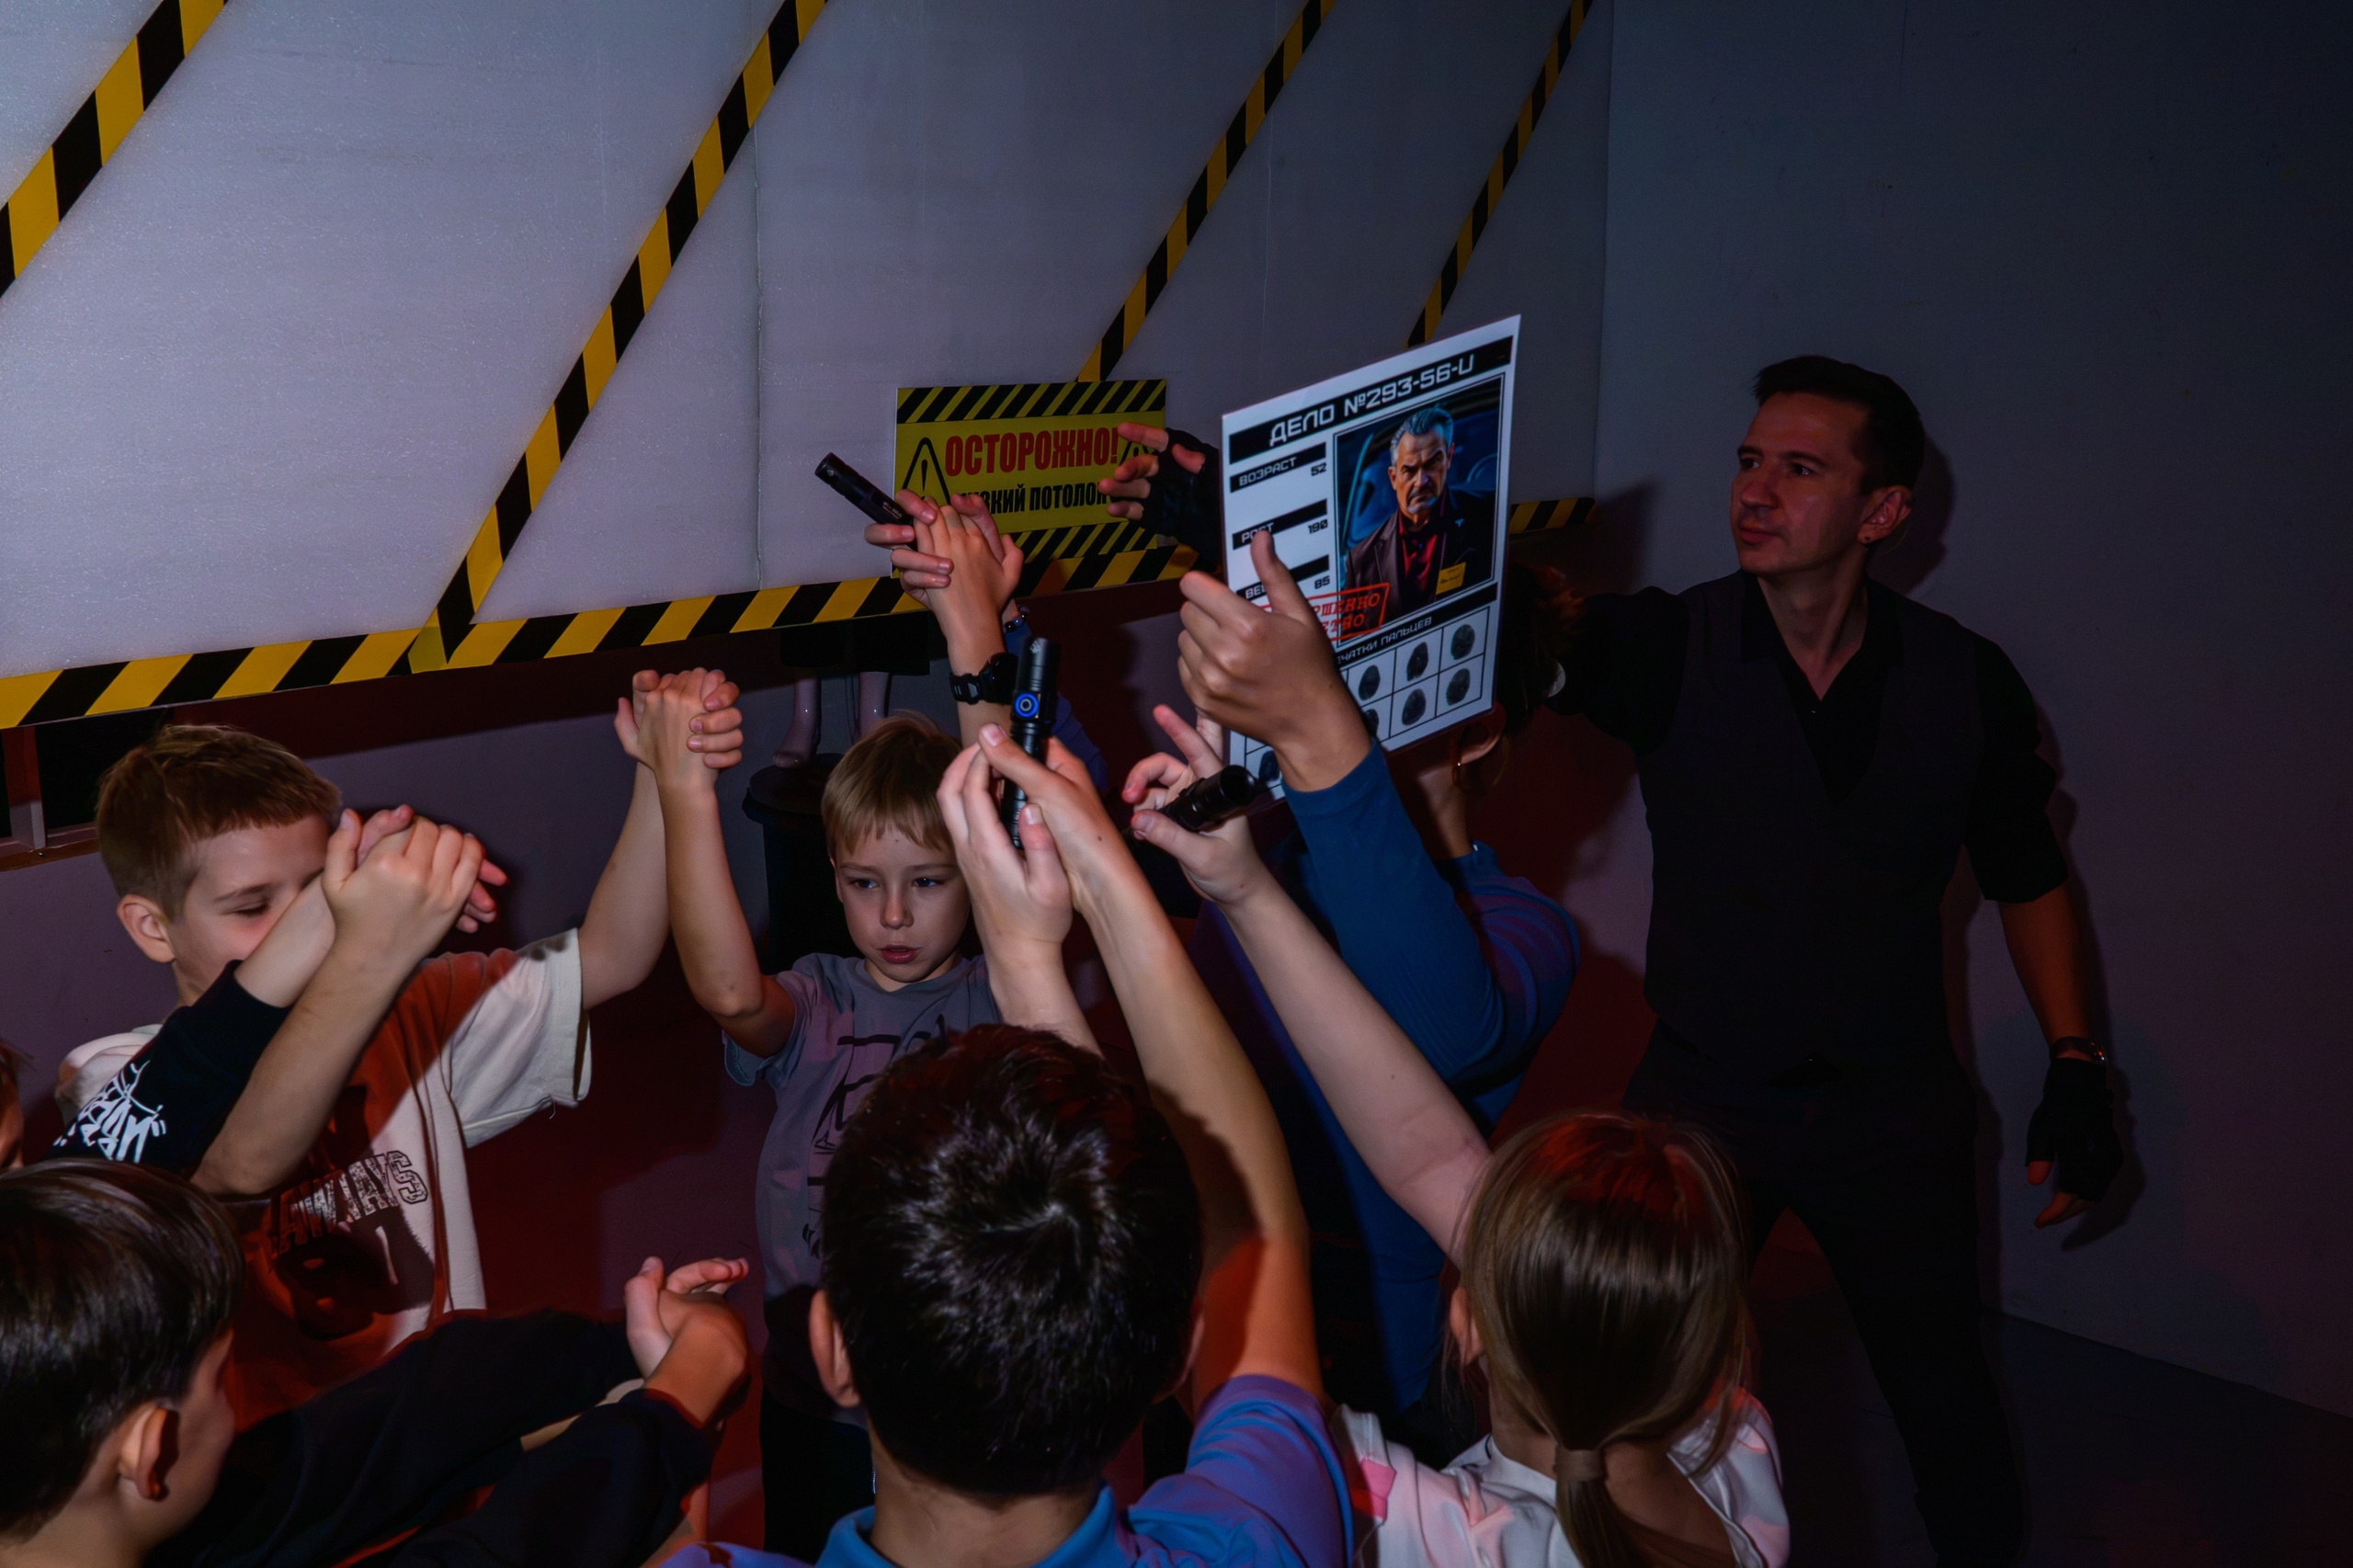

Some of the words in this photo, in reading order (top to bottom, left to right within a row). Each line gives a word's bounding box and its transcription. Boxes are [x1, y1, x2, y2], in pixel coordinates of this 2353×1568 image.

[1269, 405, 1335, 447] ДЕЛО
[945, 426, 1119, 476] ОСТОРОЖНО!
[1239, 457, 1297, 486] ВОЗРАСТ
[1311, 462, 1327, 477] 52
[961, 483, 1026, 515] ЗКИЙ
[1314, 575, 1331, 590] 85
[1381, 617, 1433, 645] ПАЛЬЦЕВ
